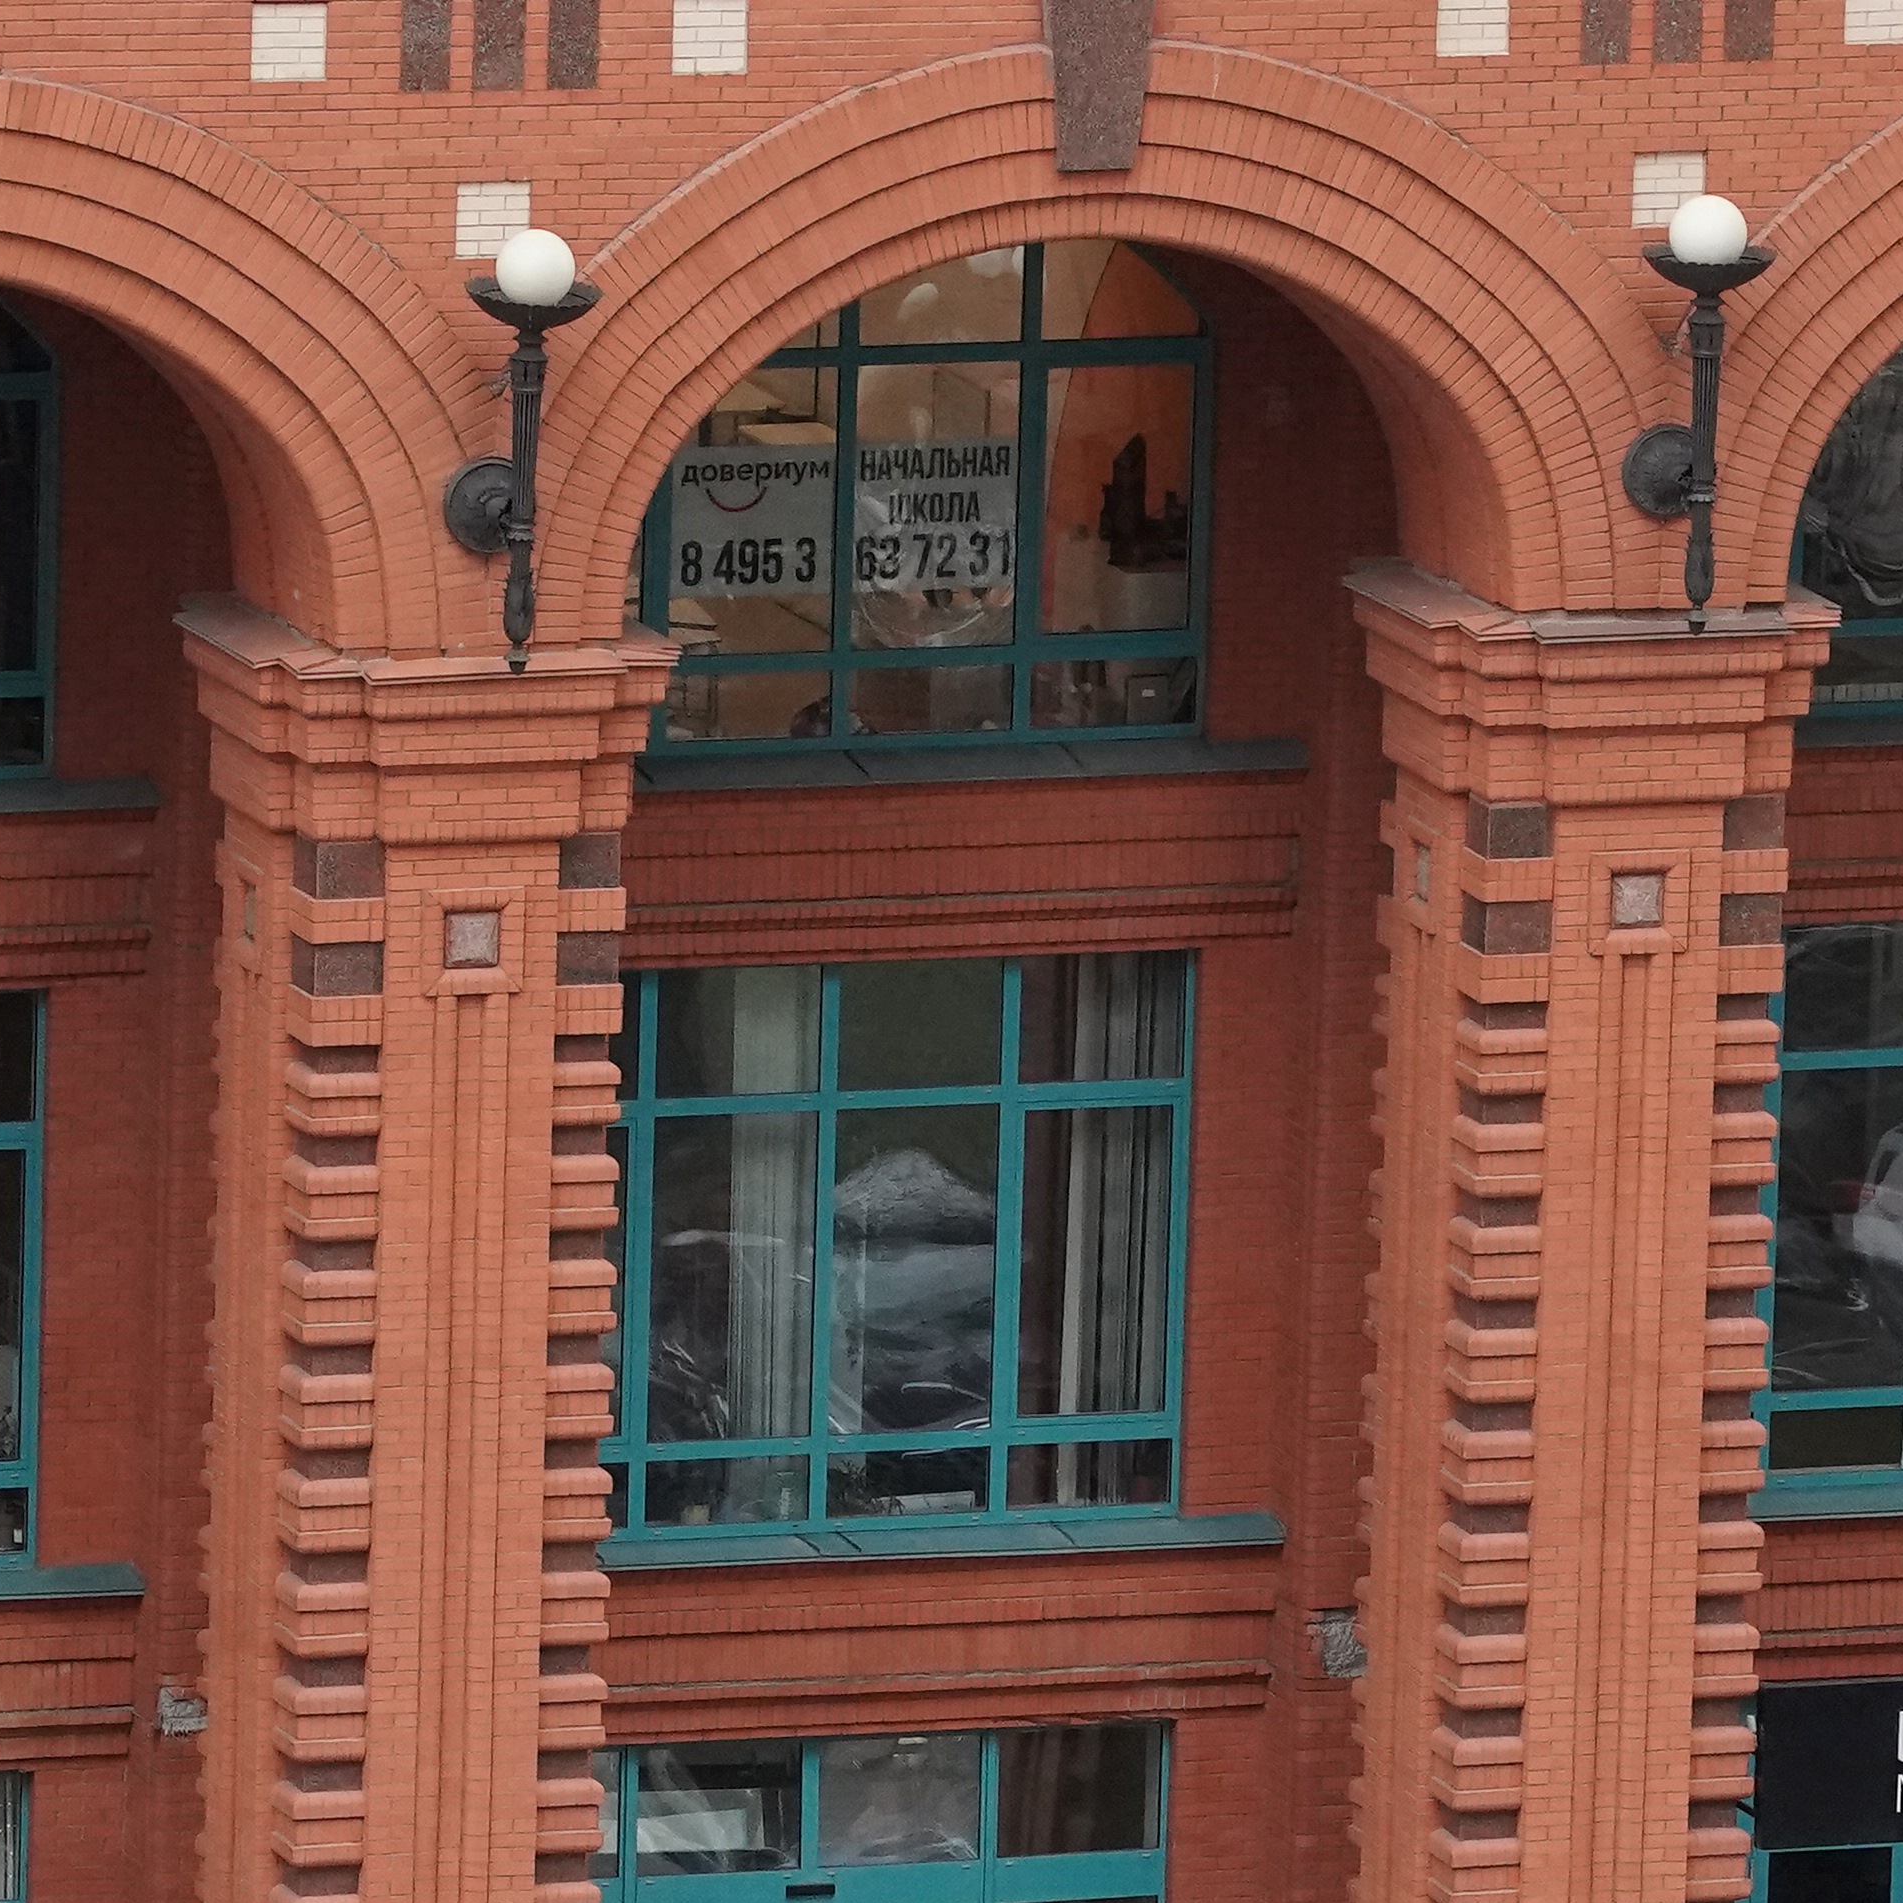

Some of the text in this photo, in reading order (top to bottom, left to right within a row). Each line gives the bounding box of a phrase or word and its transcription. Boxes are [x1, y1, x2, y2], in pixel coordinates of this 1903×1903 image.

[680, 458, 830, 487] довериум
[860, 445, 1010, 481] НАЧАЛЬНАЯ
[888, 491, 981, 526] ШКОЛА
[680, 537, 816, 587] 8 495 3
[856, 532, 1011, 581] 63 72 31
